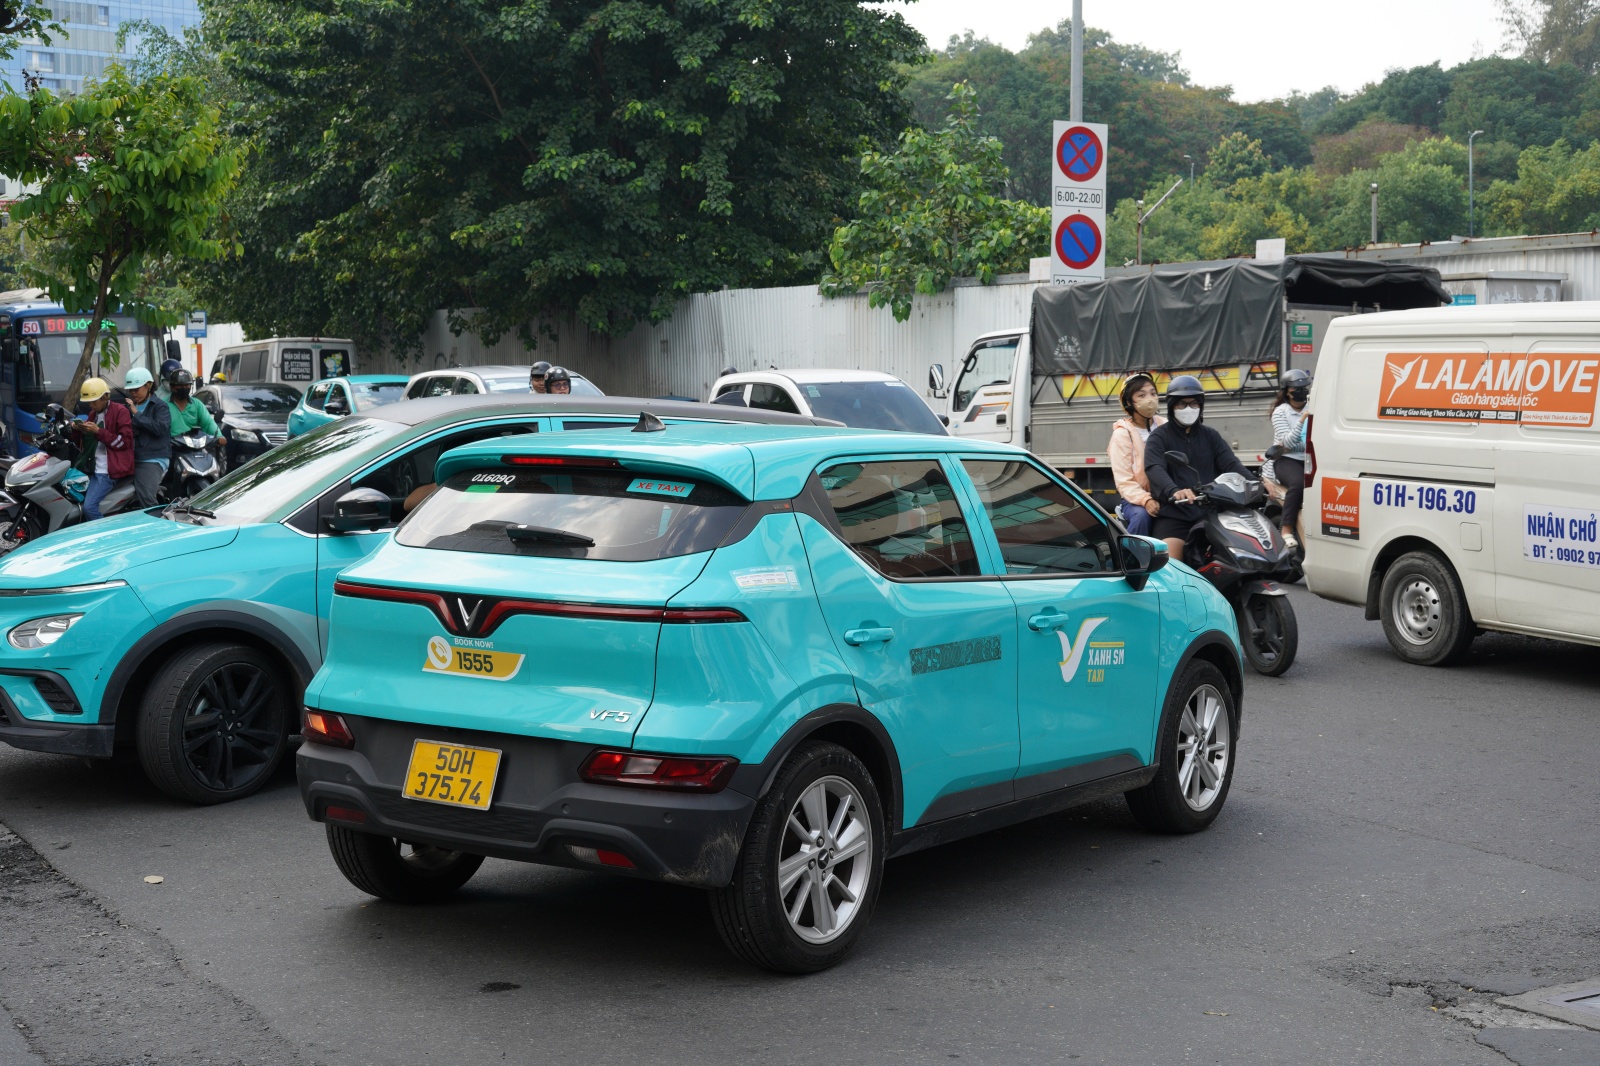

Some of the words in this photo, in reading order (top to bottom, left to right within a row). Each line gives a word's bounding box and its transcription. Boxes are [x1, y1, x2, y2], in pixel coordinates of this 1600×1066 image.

[1057, 191, 1101, 204] 6:00-22:00
[23, 322, 38, 333] 50
[47, 318, 65, 332] 50
[1415, 359, 1599, 393] LALAMOVE
[1451, 393, 1473, 405] Giao
[1473, 392, 1500, 408] hàng
[1500, 394, 1521, 406] siêu
[1521, 393, 1538, 406] tốc
[1408, 408, 1419, 416] Giao
[1420, 408, 1433, 417] Hàng
[1433, 409, 1446, 417] Theo
[1446, 409, 1455, 417] Yêu
[471, 473, 516, 485] 01609Q
[636, 481, 653, 491] XE
[657, 482, 685, 493] TAXI
[1373, 483, 1476, 514] 61H-196.30
[1323, 502, 1358, 514] LALAMOVE
[1528, 511, 1564, 543] NHẬN
[1569, 513, 1597, 543] CHỞ
[1533, 544, 1546, 558] ĐT
[1557, 547, 1585, 563] 0902
[1588, 550, 1600, 565] 97
[454, 637, 474, 648] BOOK
[474, 638, 494, 649] NOW!
[456, 651, 494, 673] 1555
[1088, 648, 1112, 666] XANH
[1113, 648, 1125, 665] SM
[1087, 669, 1104, 683] TAXI
[589, 707, 633, 723] VF5
[435, 746, 473, 773] 50H
[414, 772, 483, 805] 375.74
